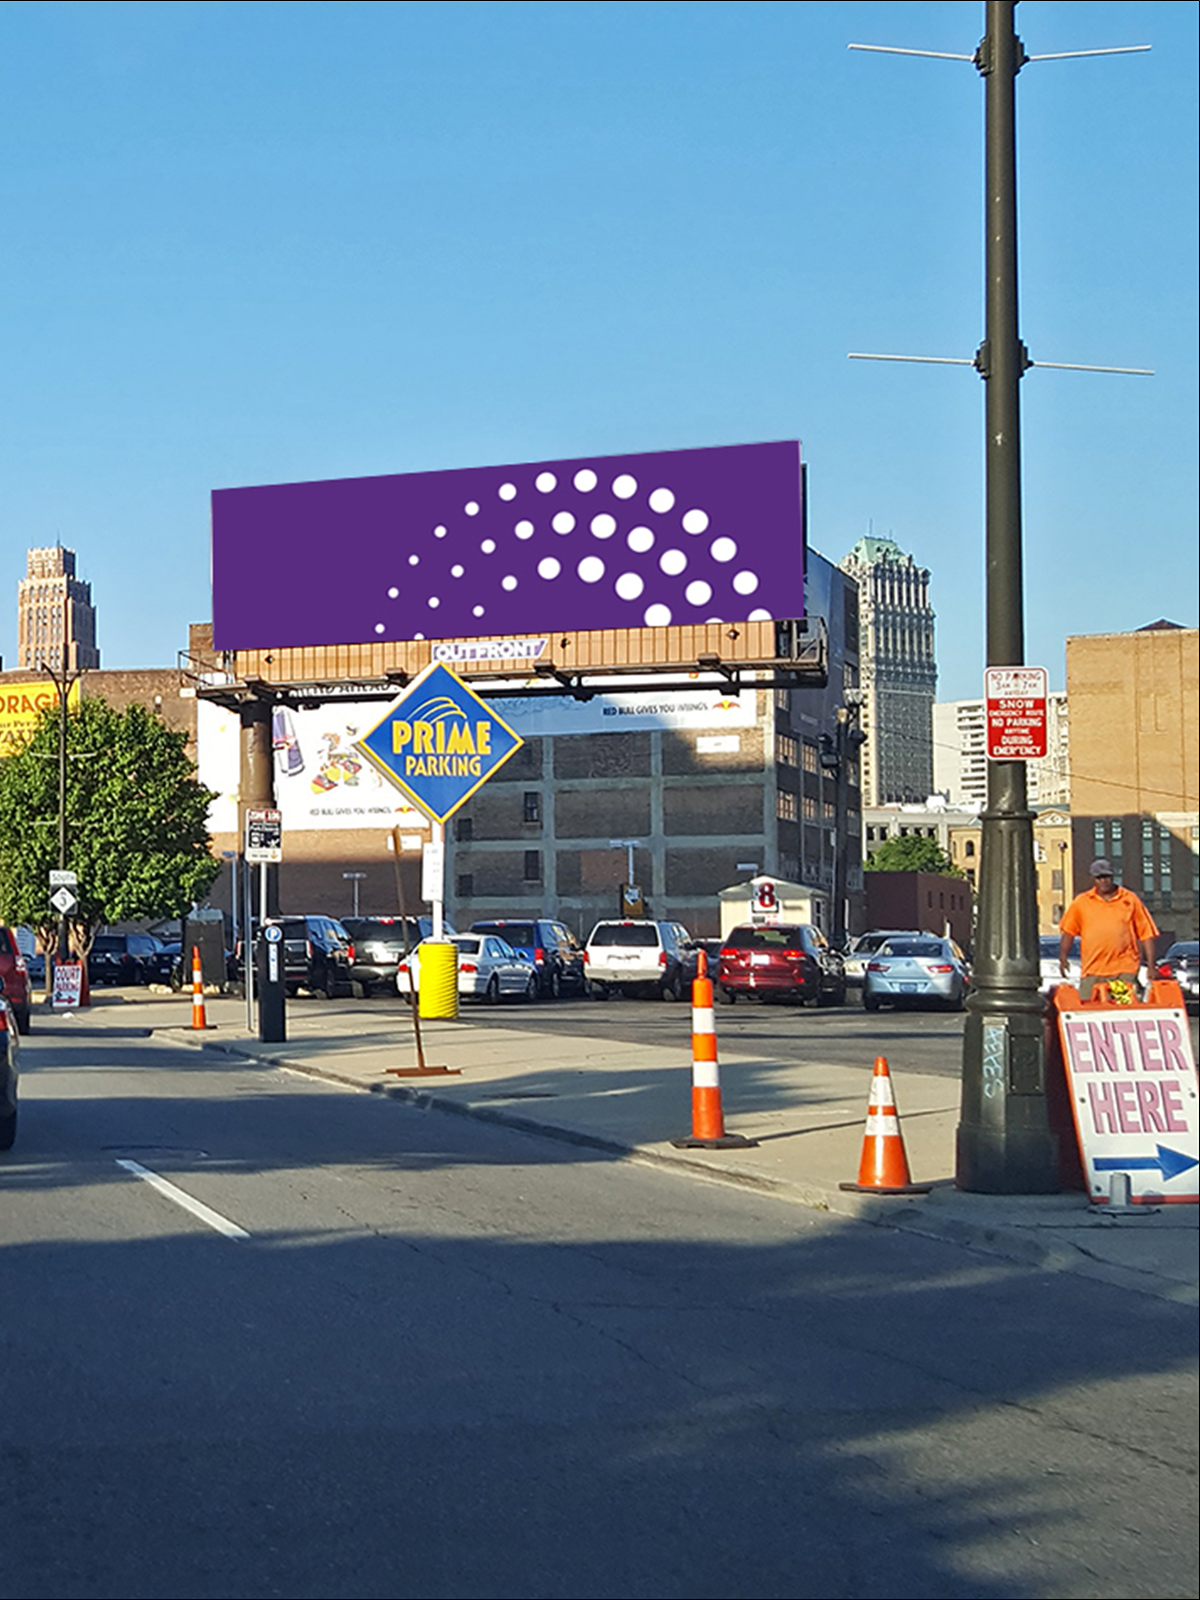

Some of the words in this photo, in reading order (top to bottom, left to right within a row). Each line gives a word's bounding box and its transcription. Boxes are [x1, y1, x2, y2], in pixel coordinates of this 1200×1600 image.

[437, 641, 541, 660] OUTFRONT
[991, 672, 1003, 680] NO
[603, 706, 617, 716] RED
[619, 705, 635, 715] BULL
[636, 704, 658, 714] GIVES
[659, 703, 675, 713] YOU
[999, 700, 1035, 709] SNOW
[991, 718, 1004, 727] NO
[1006, 718, 1042, 727] PARKING
[392, 720, 491, 755] PRIME
[1001, 735, 1033, 745] DURING
[406, 755, 481, 776] PARKING
[758, 882, 776, 908] 8
[1065, 1020, 1189, 1072] ENTER
[1087, 1081, 1188, 1134] HERE
